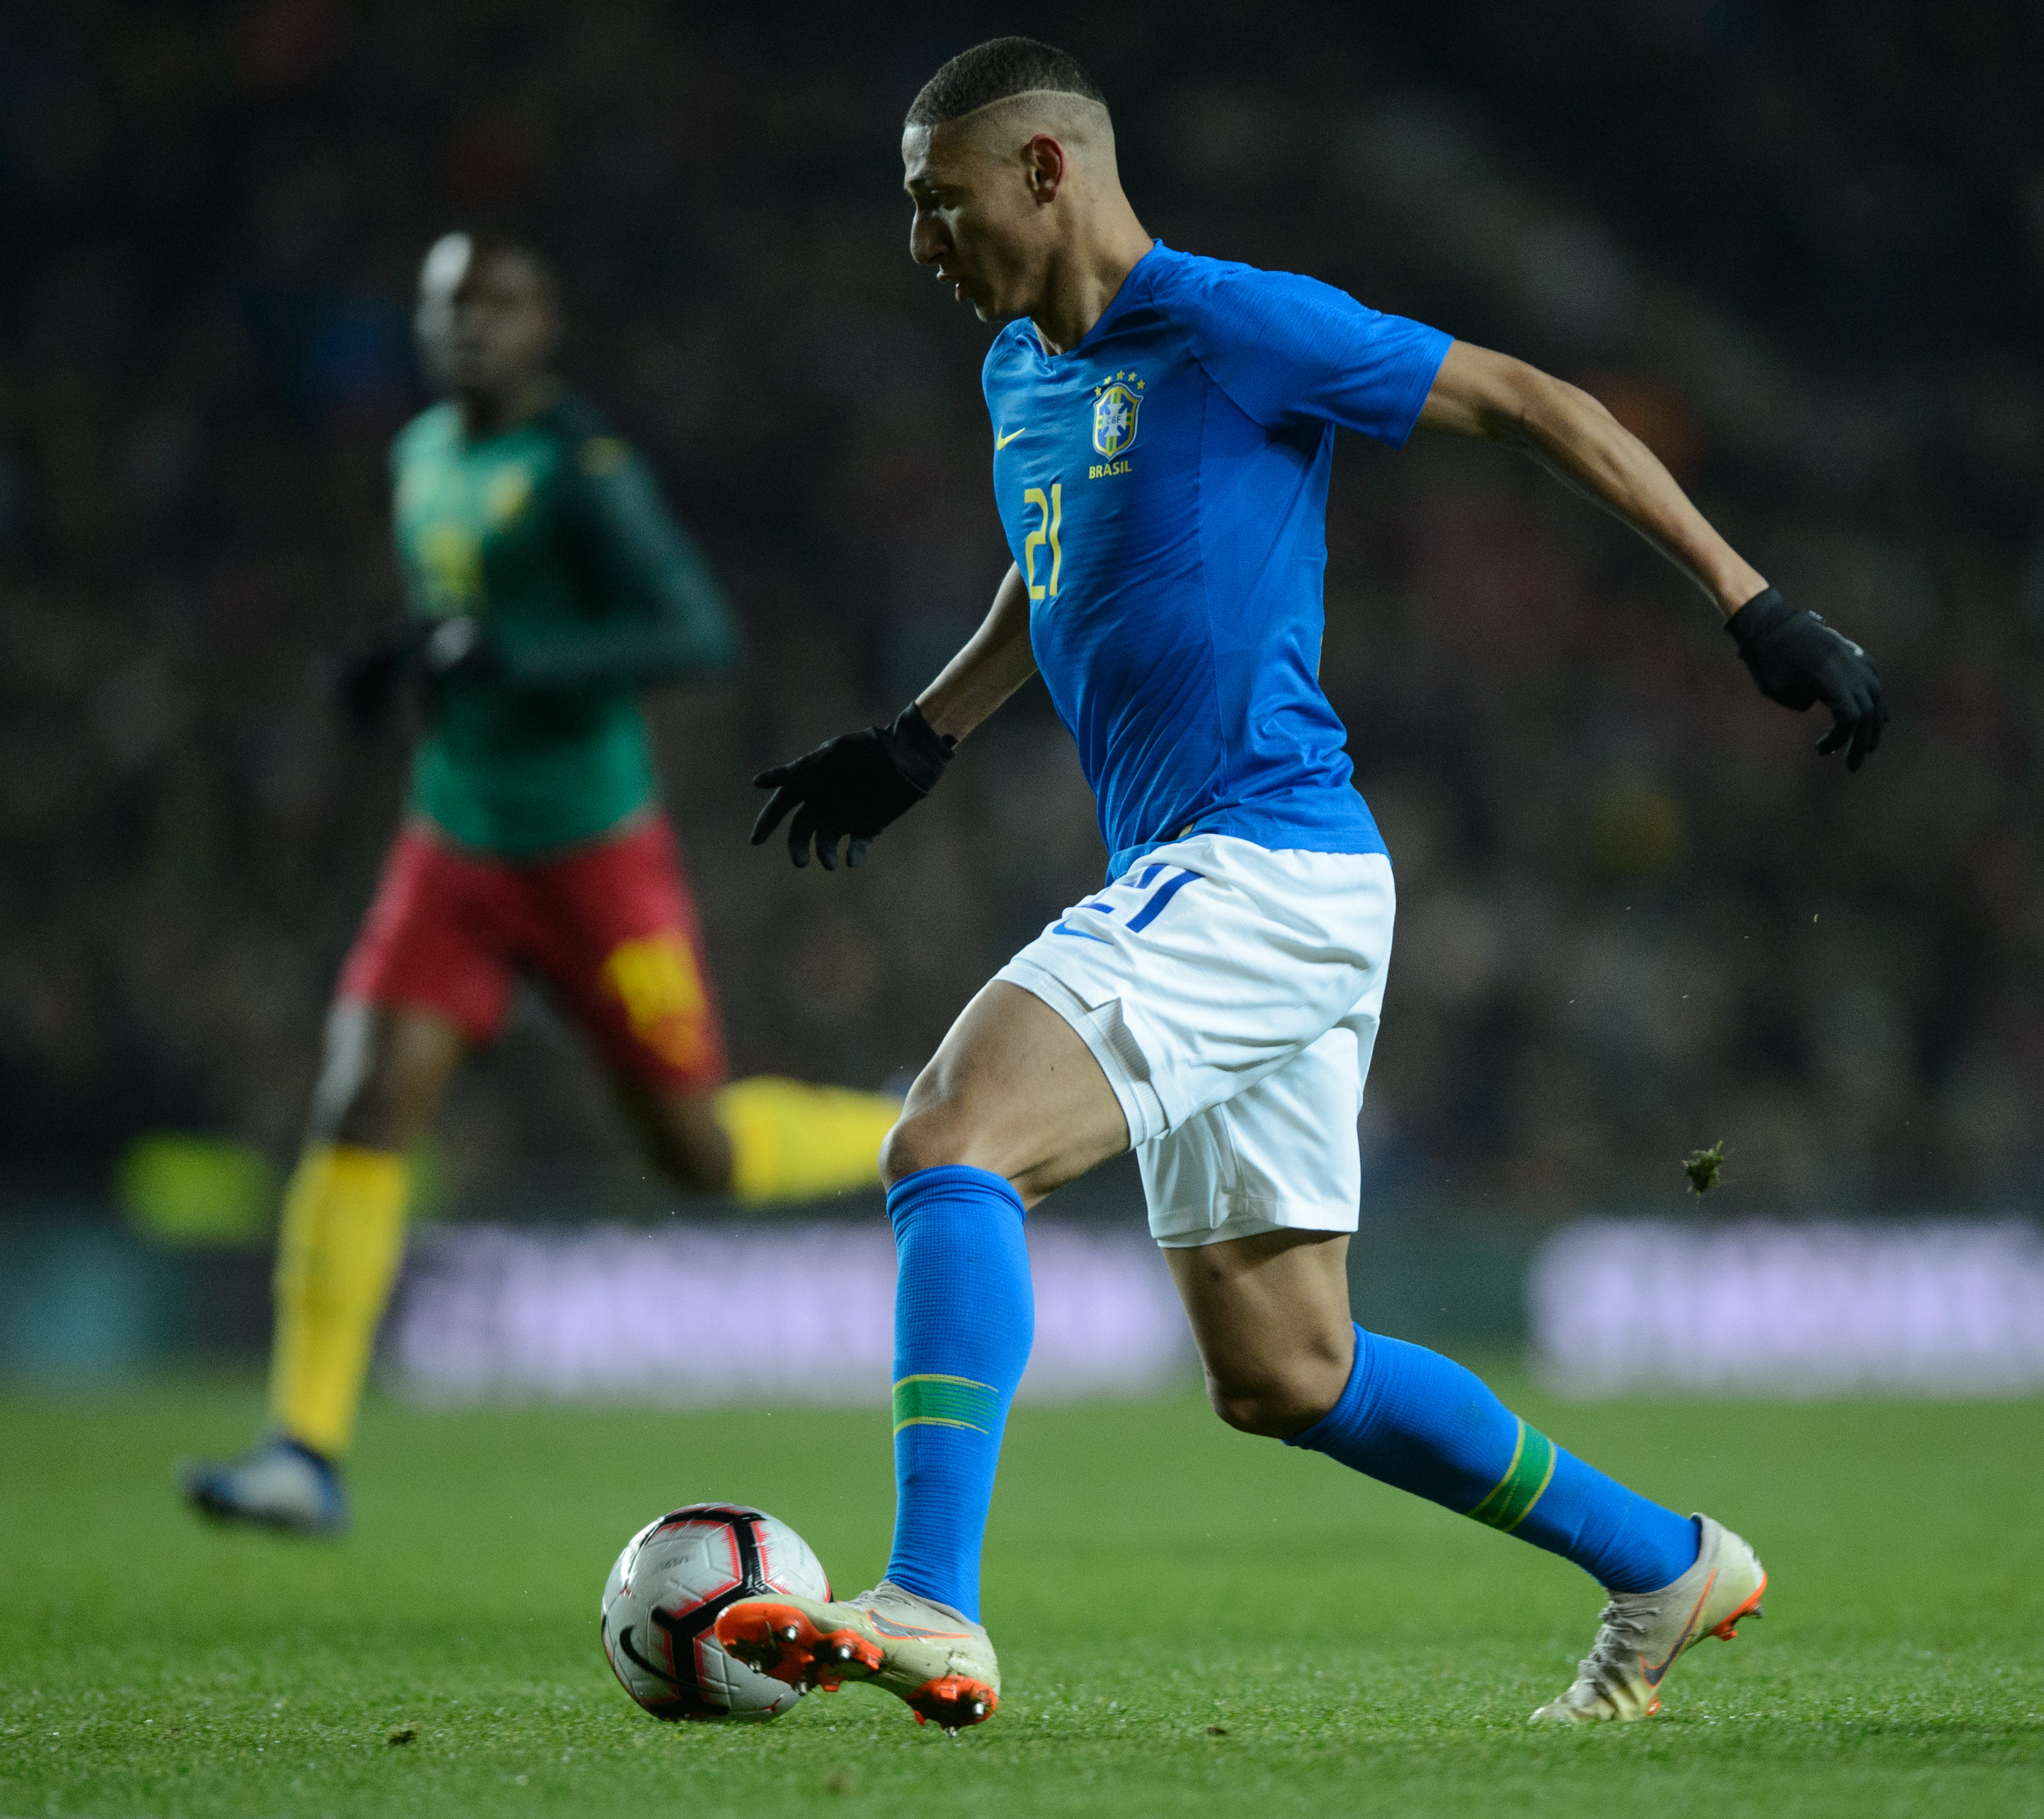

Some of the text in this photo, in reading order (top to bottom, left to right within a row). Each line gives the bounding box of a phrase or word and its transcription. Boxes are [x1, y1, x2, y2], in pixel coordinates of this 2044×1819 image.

[1106, 416, 1121, 424] CBF
[1089, 461, 1132, 479] BRASIL
[1024, 484, 1062, 600] 21
